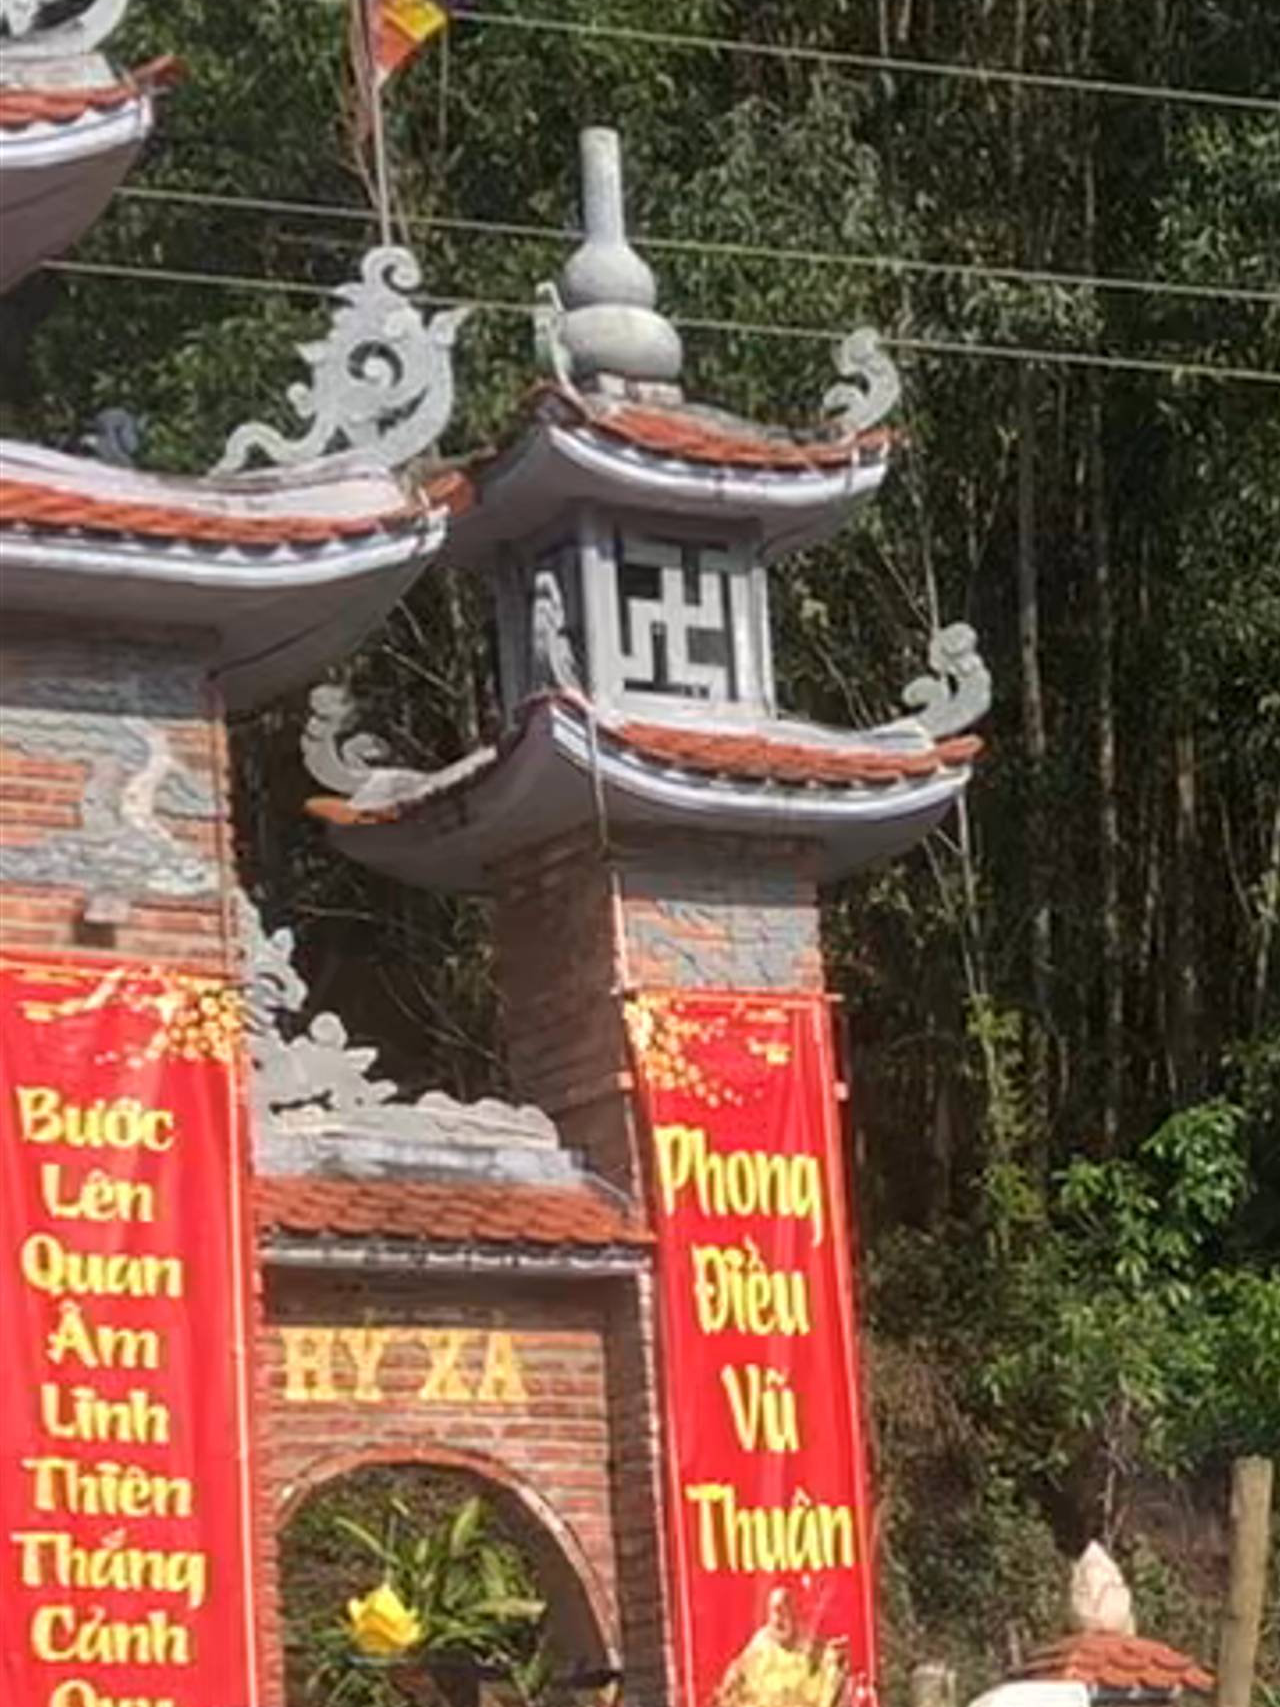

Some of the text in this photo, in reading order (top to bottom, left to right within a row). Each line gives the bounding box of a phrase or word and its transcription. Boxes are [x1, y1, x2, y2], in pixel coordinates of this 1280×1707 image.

[14, 1085, 174, 1151] Bước
[41, 1163, 154, 1223] Lên
[653, 1123, 824, 1247] Phong
[21, 1233, 183, 1297] Quan
[691, 1233, 810, 1336] Điều
[46, 1299, 159, 1370] Âm
[40, 1383, 171, 1444] Linh
[719, 1363, 800, 1454] Vũ
[22, 1456, 192, 1518] Thiên
[10, 1527, 207, 1609] Thắng
[684, 1484, 854, 1586] Thuận
[31, 1604, 191, 1664] Cảnh
